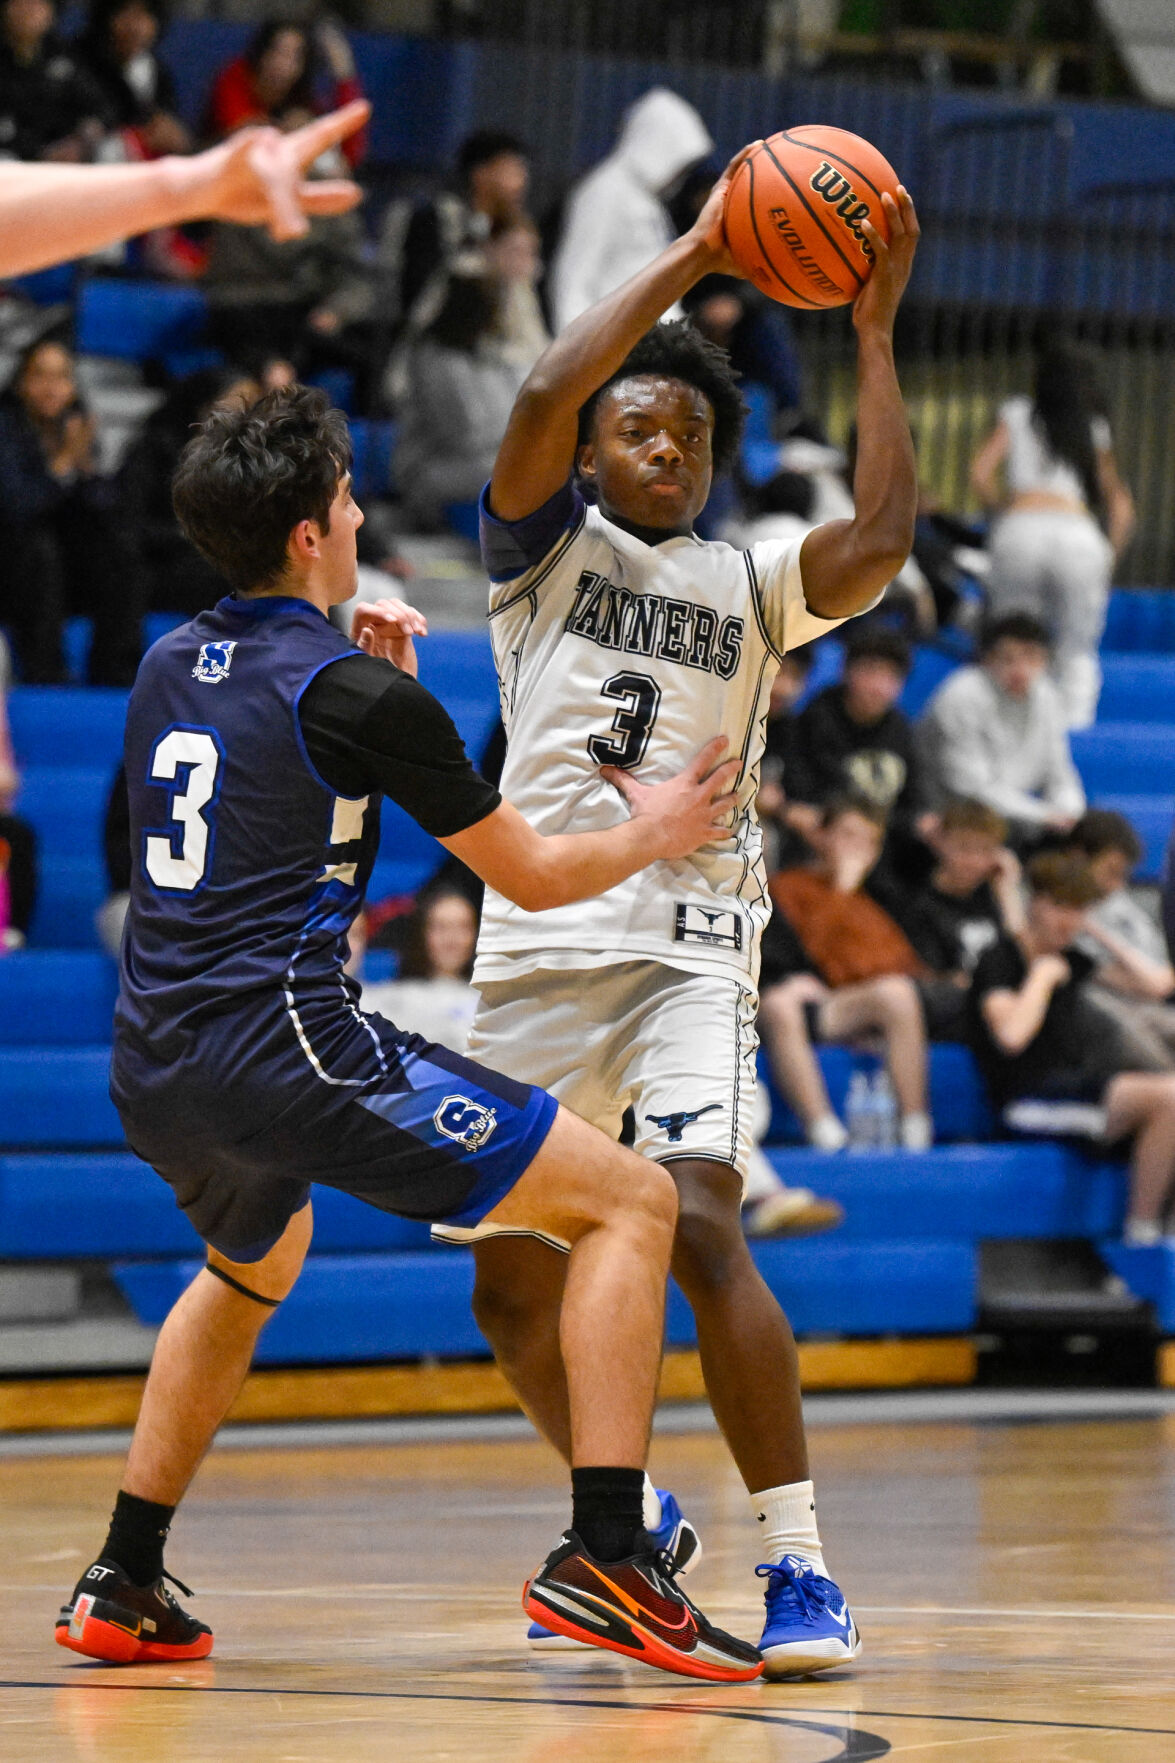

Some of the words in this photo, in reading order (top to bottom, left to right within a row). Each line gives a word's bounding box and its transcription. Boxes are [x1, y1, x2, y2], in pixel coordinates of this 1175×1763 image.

[767, 206, 844, 297] EVOLUTION
[191, 664, 209, 679] Big
[209, 663, 230, 679] Blue
[564, 570, 745, 681] TANNERS
[587, 670, 662, 769] 3
[144, 726, 222, 894] 3
[86, 1564, 116, 1582] GT
